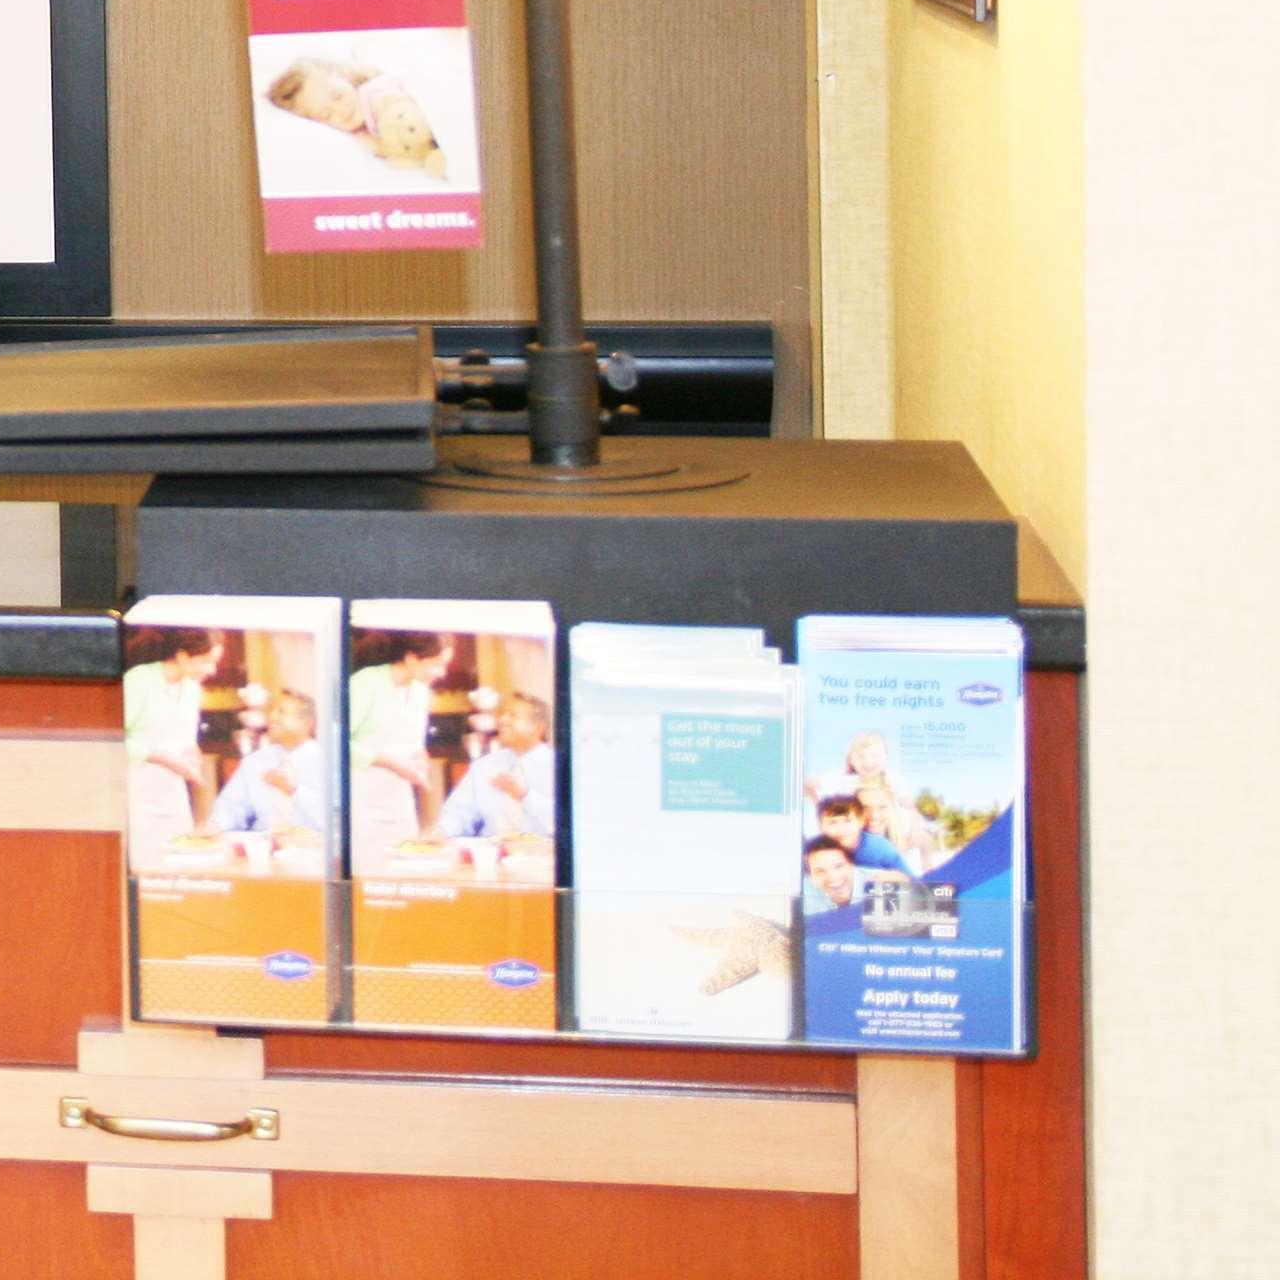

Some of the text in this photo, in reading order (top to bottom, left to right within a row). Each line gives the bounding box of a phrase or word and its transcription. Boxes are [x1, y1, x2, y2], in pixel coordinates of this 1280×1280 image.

[314, 209, 475, 232] sweet dreams.
[819, 673, 942, 691] You could earn
[819, 691, 849, 706] two
[854, 692, 887, 707] free
[892, 693, 945, 709] nights
[864, 964, 957, 980] No annual fee
[862, 989, 960, 1009] Apply today
